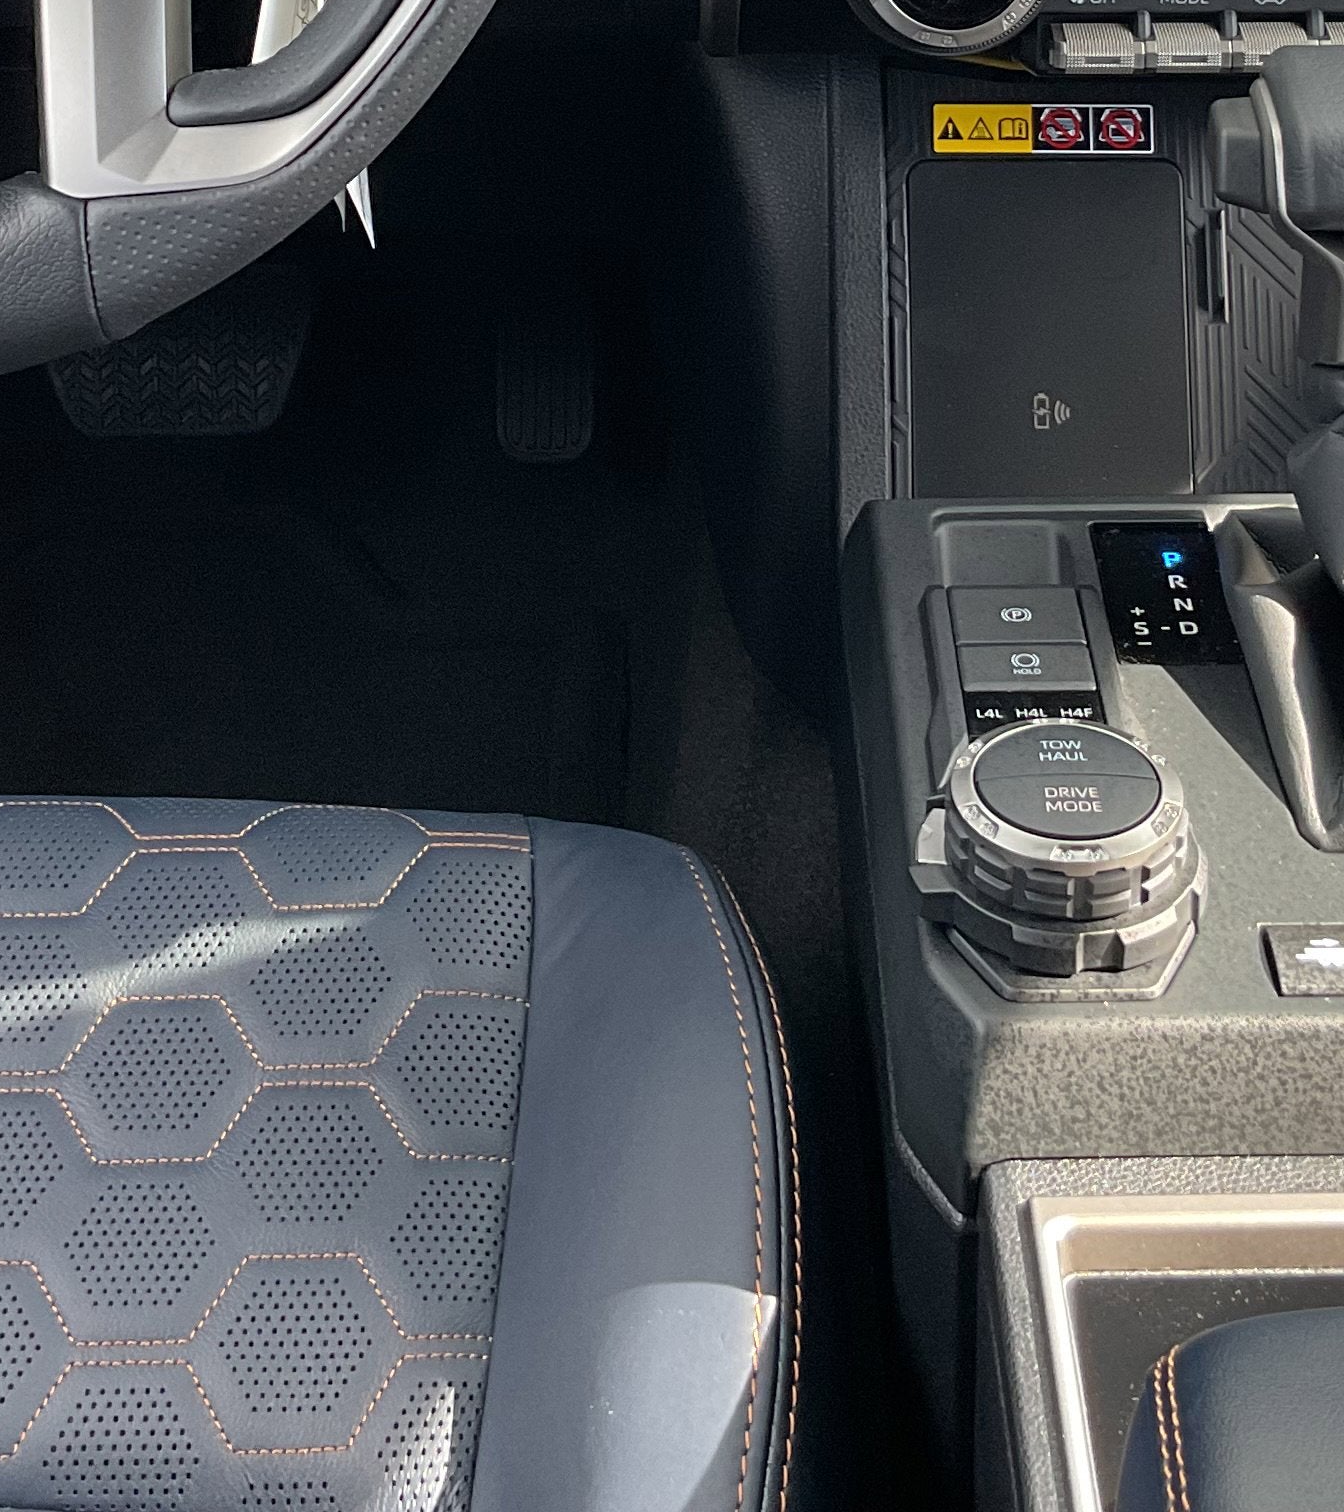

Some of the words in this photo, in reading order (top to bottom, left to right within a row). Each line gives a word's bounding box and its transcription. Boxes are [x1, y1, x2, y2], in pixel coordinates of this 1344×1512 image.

[1161, 551, 1183, 568] P
[1167, 574, 1188, 589] R
[1173, 597, 1194, 612] N
[1133, 621, 1150, 636] S
[1178, 621, 1199, 635] D
[1012, 666, 1043, 676] HOLD
[975, 708, 1004, 719] L4L
[1015, 707, 1049, 720] H4L
[1058, 706, 1095, 719] H4F
[1039, 740, 1082, 750] TOW
[1038, 751, 1088, 762] HAUL
[1044, 786, 1099, 799] DRIVE
[1045, 800, 1103, 813] MODE
